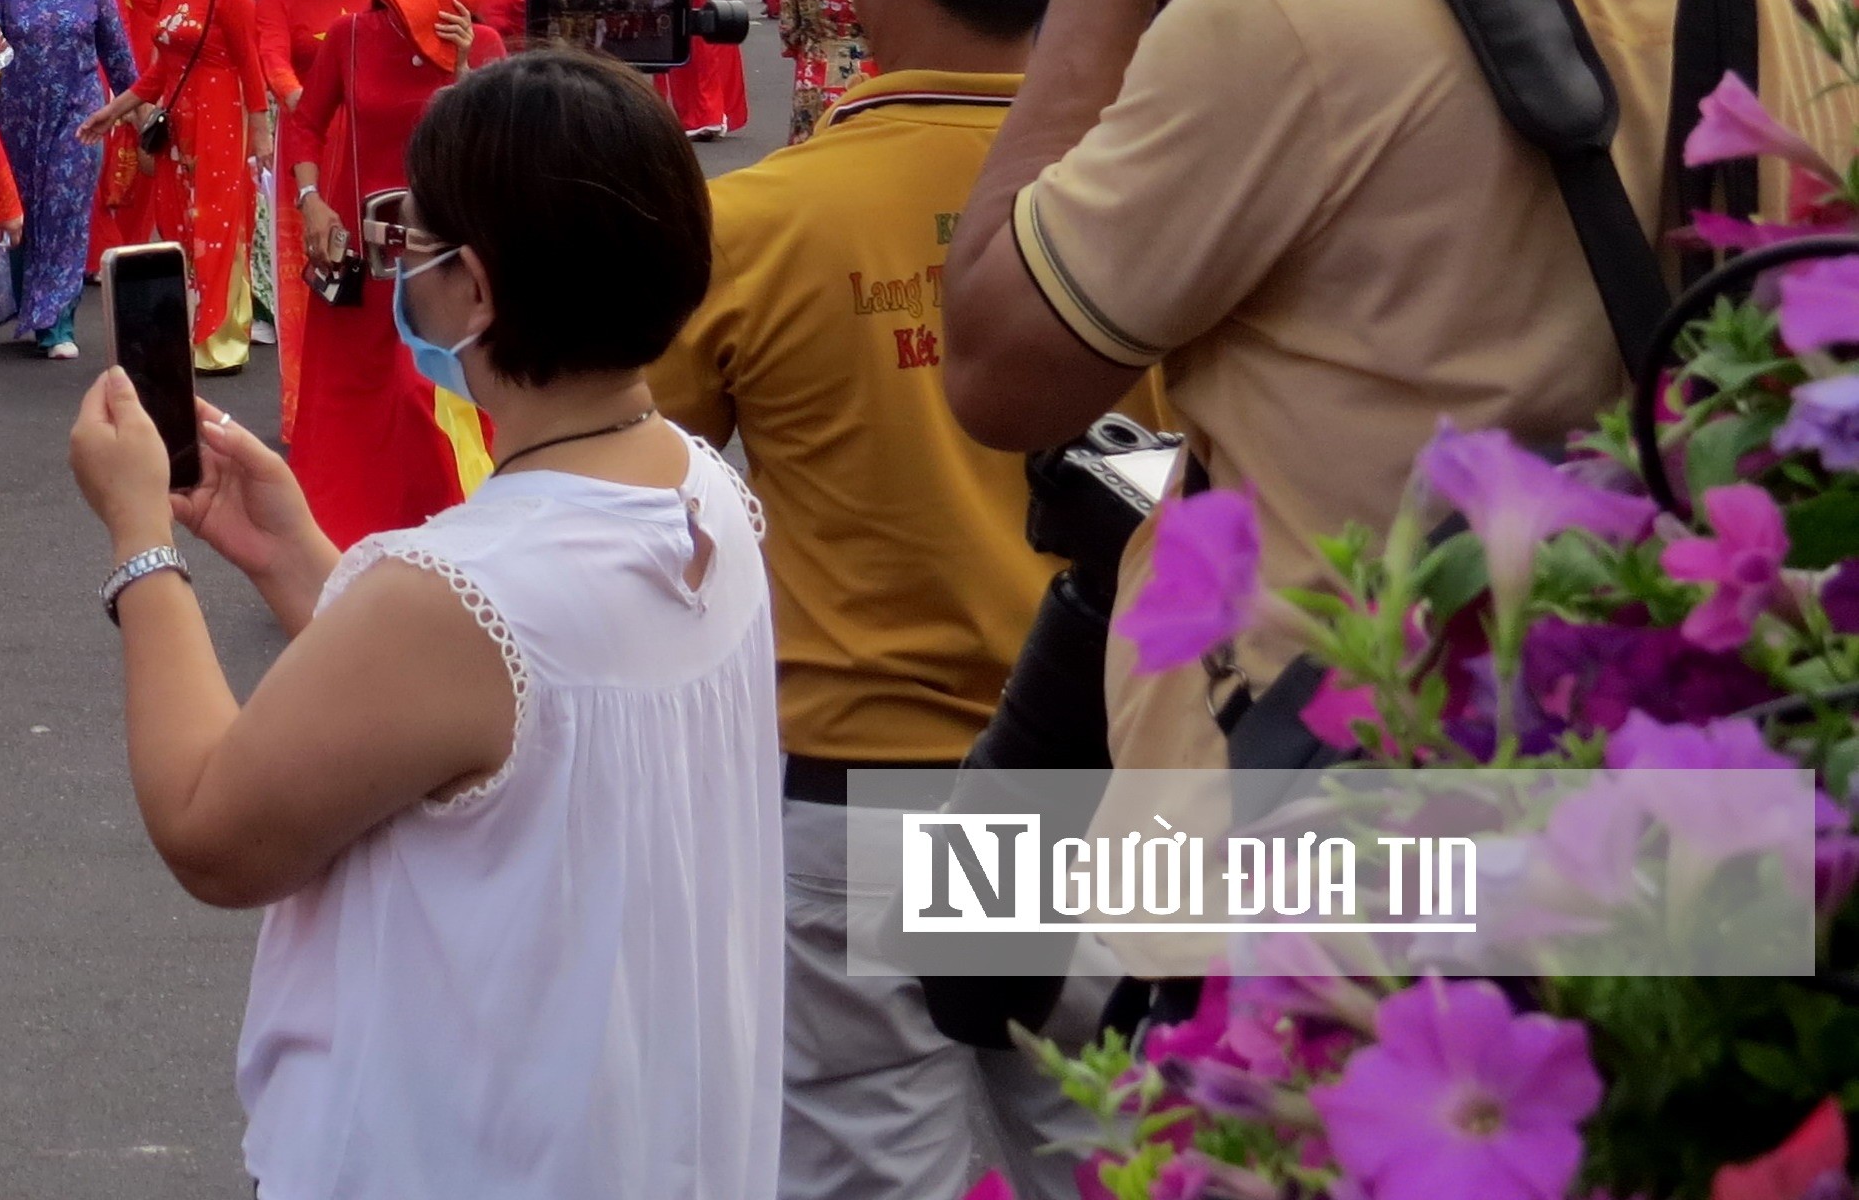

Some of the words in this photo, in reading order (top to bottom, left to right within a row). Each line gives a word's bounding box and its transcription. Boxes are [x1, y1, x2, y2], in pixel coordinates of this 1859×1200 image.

[934, 212, 960, 245] K
[849, 271, 923, 319] Lang
[926, 265, 946, 308] T
[894, 323, 940, 370] Kết
